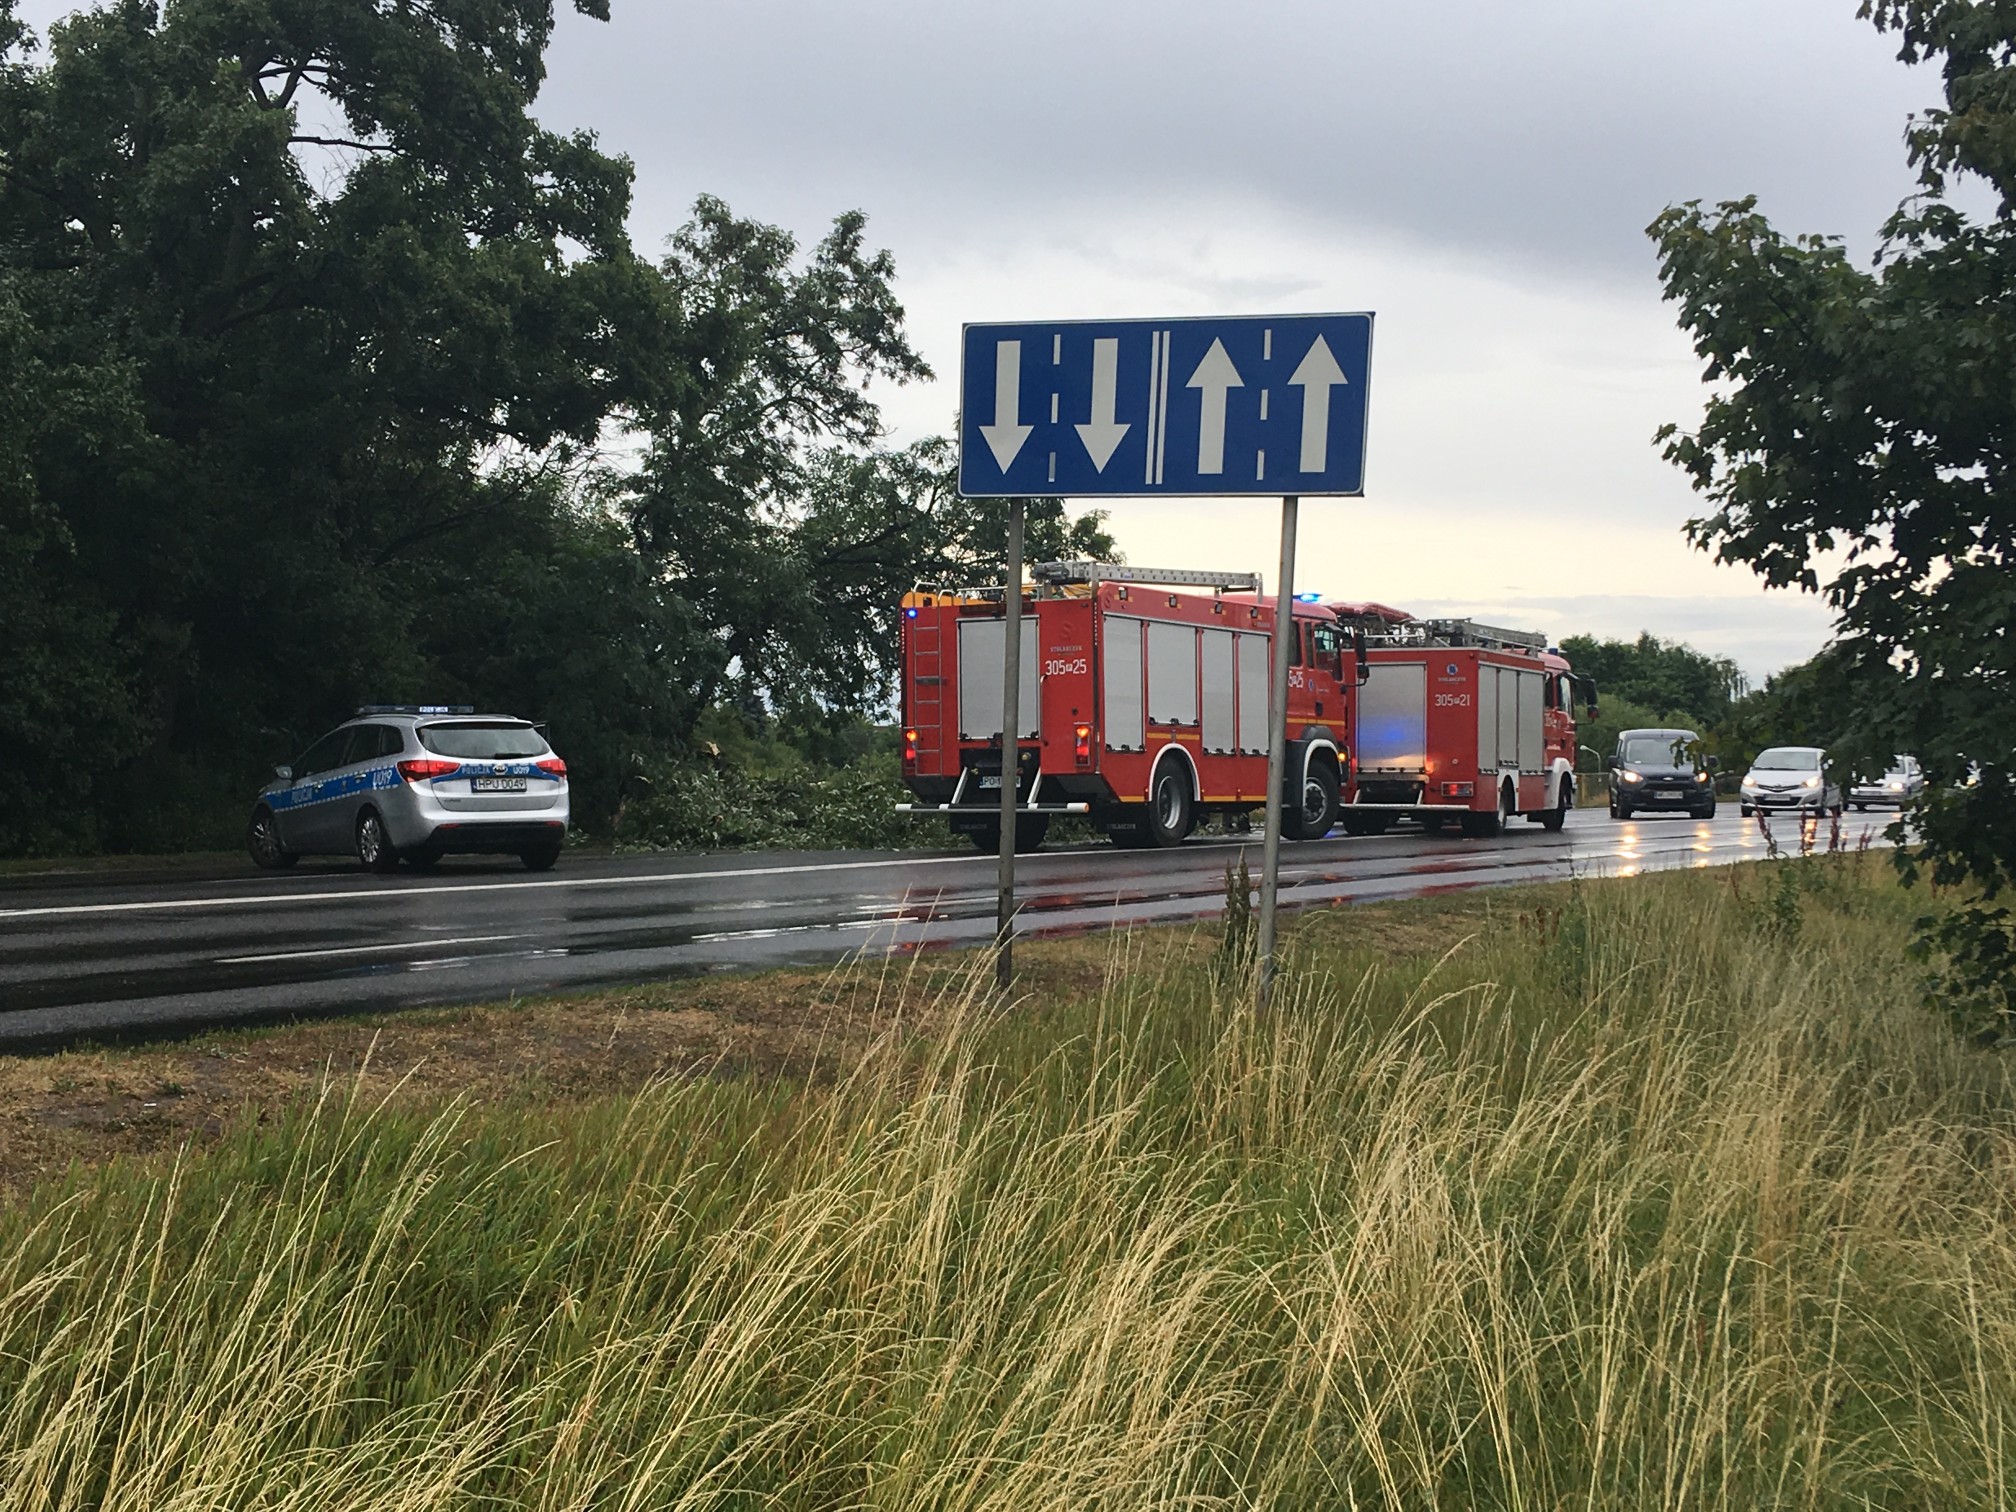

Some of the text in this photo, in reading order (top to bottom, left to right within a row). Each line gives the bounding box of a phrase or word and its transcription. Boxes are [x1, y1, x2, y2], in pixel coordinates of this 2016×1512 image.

[462, 765, 491, 775] POLICJA
[477, 778, 525, 789] HPU 0049
